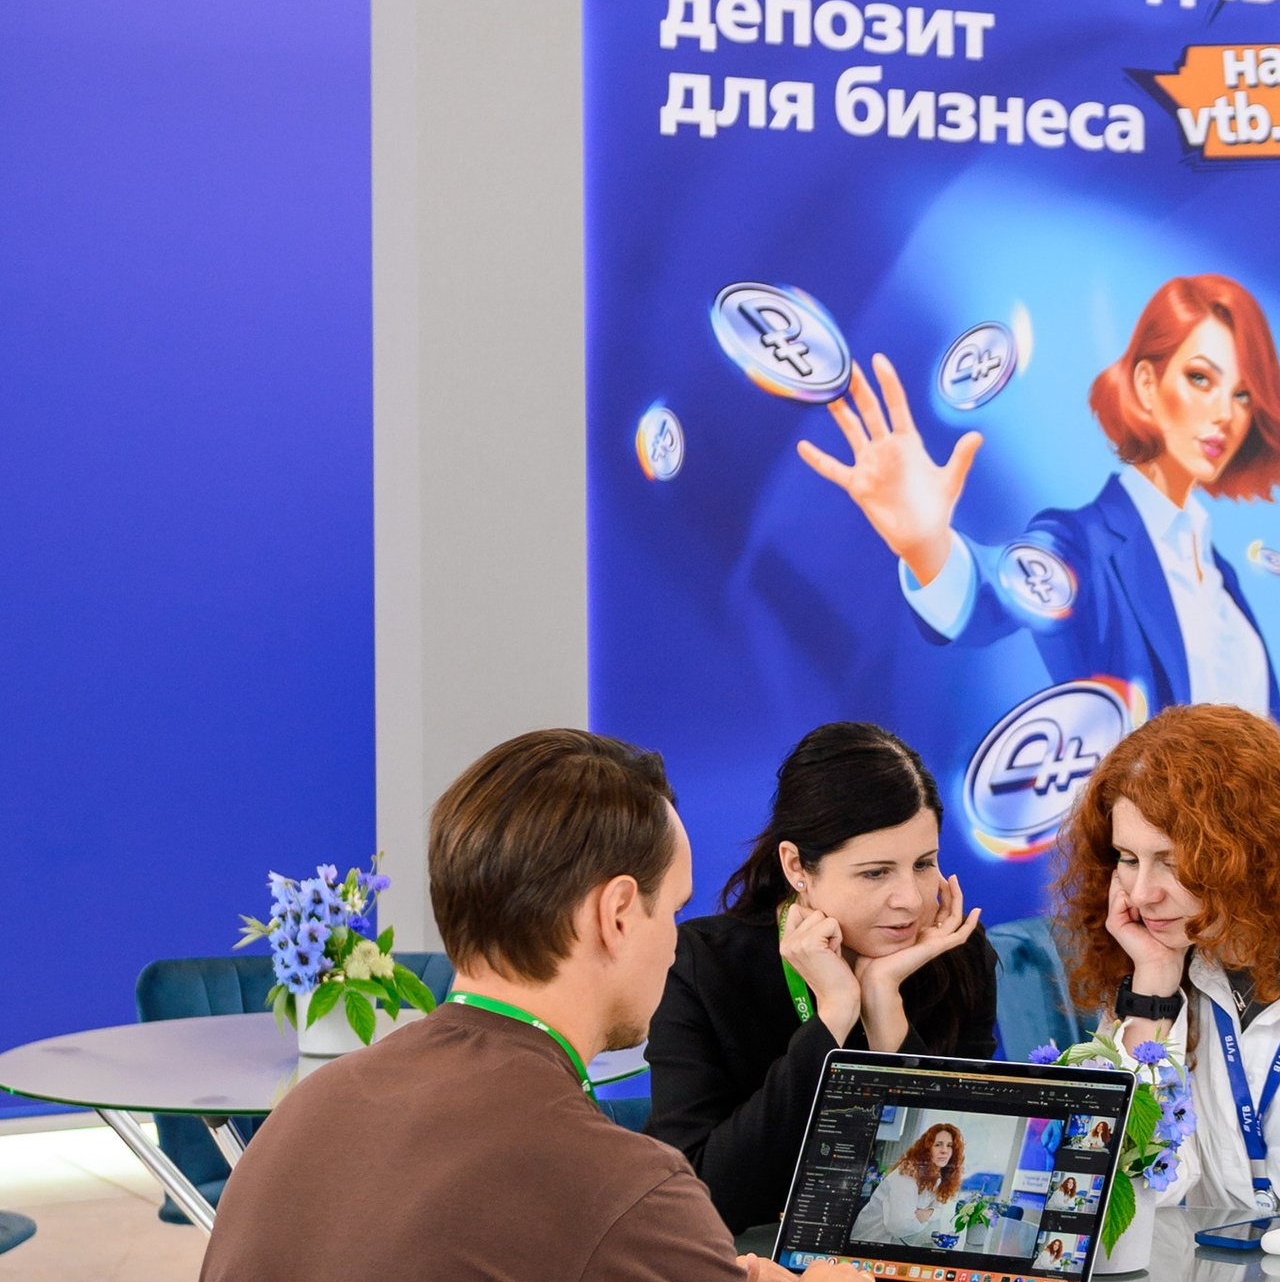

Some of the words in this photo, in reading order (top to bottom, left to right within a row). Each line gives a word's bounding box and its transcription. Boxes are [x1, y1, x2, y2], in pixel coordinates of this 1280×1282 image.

[660, 71, 815, 138] для
[834, 65, 1146, 153] бизнеса
[1224, 1035, 1236, 1055] VTB
[1241, 1105, 1253, 1125] VTB
